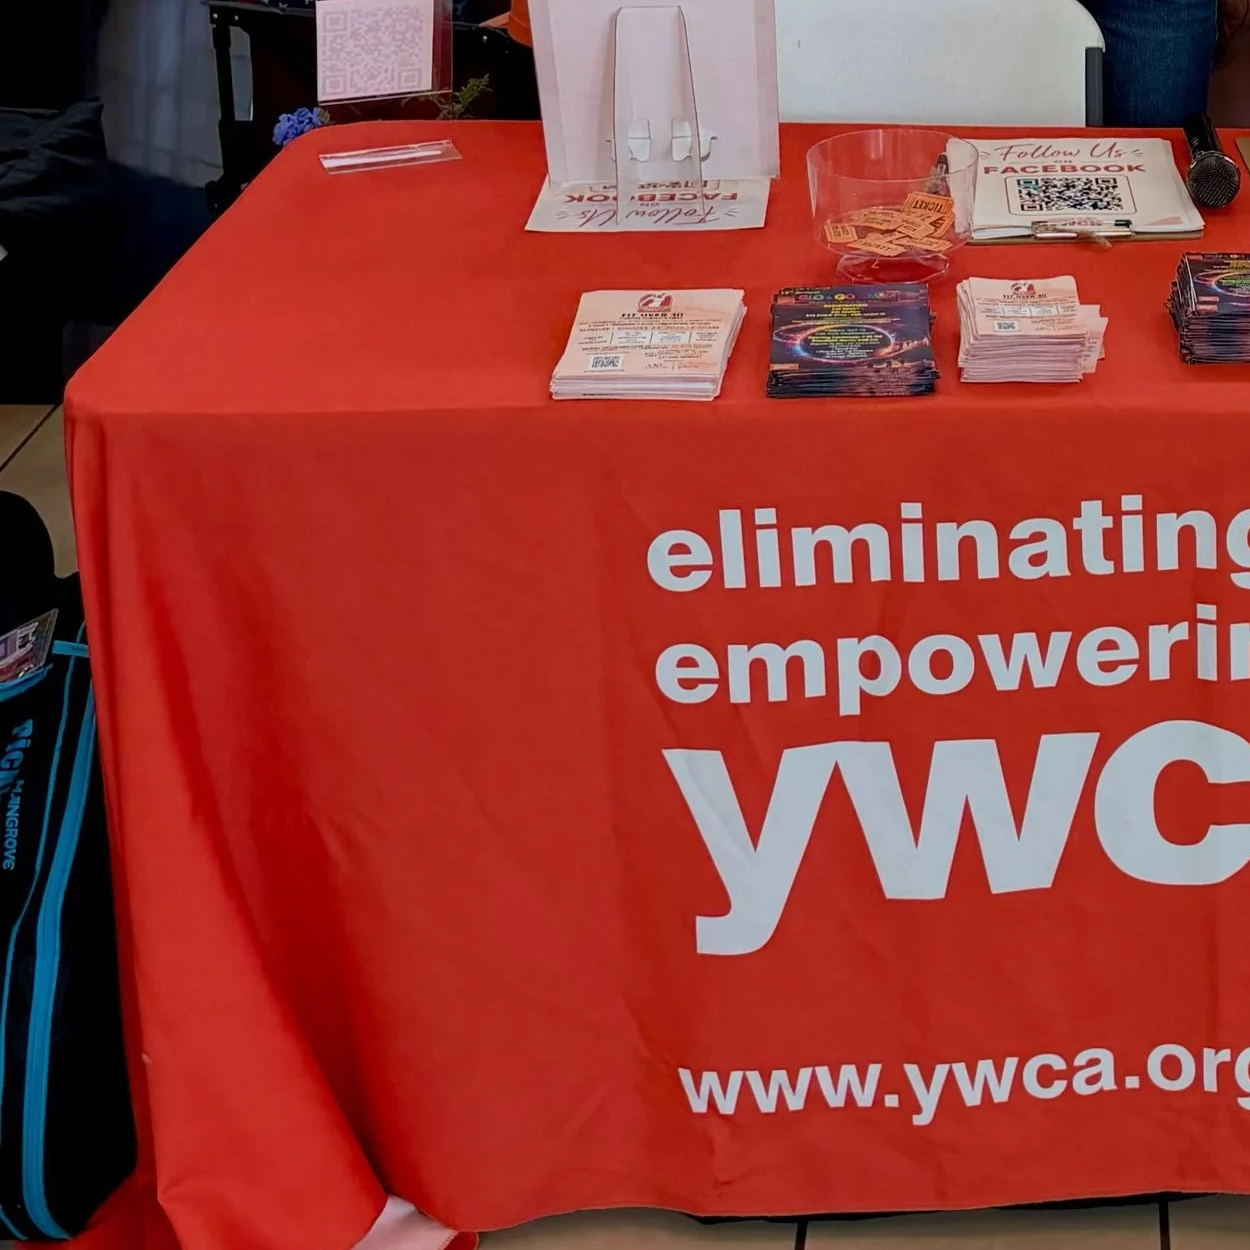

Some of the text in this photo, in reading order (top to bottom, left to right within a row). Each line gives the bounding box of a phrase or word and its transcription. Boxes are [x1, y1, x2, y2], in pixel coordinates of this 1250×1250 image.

[994, 142, 1126, 161] Follow Us
[984, 164, 1146, 174] FACEBOOK
[912, 199, 943, 213] TICKET
[573, 207, 720, 228] Follow Us
